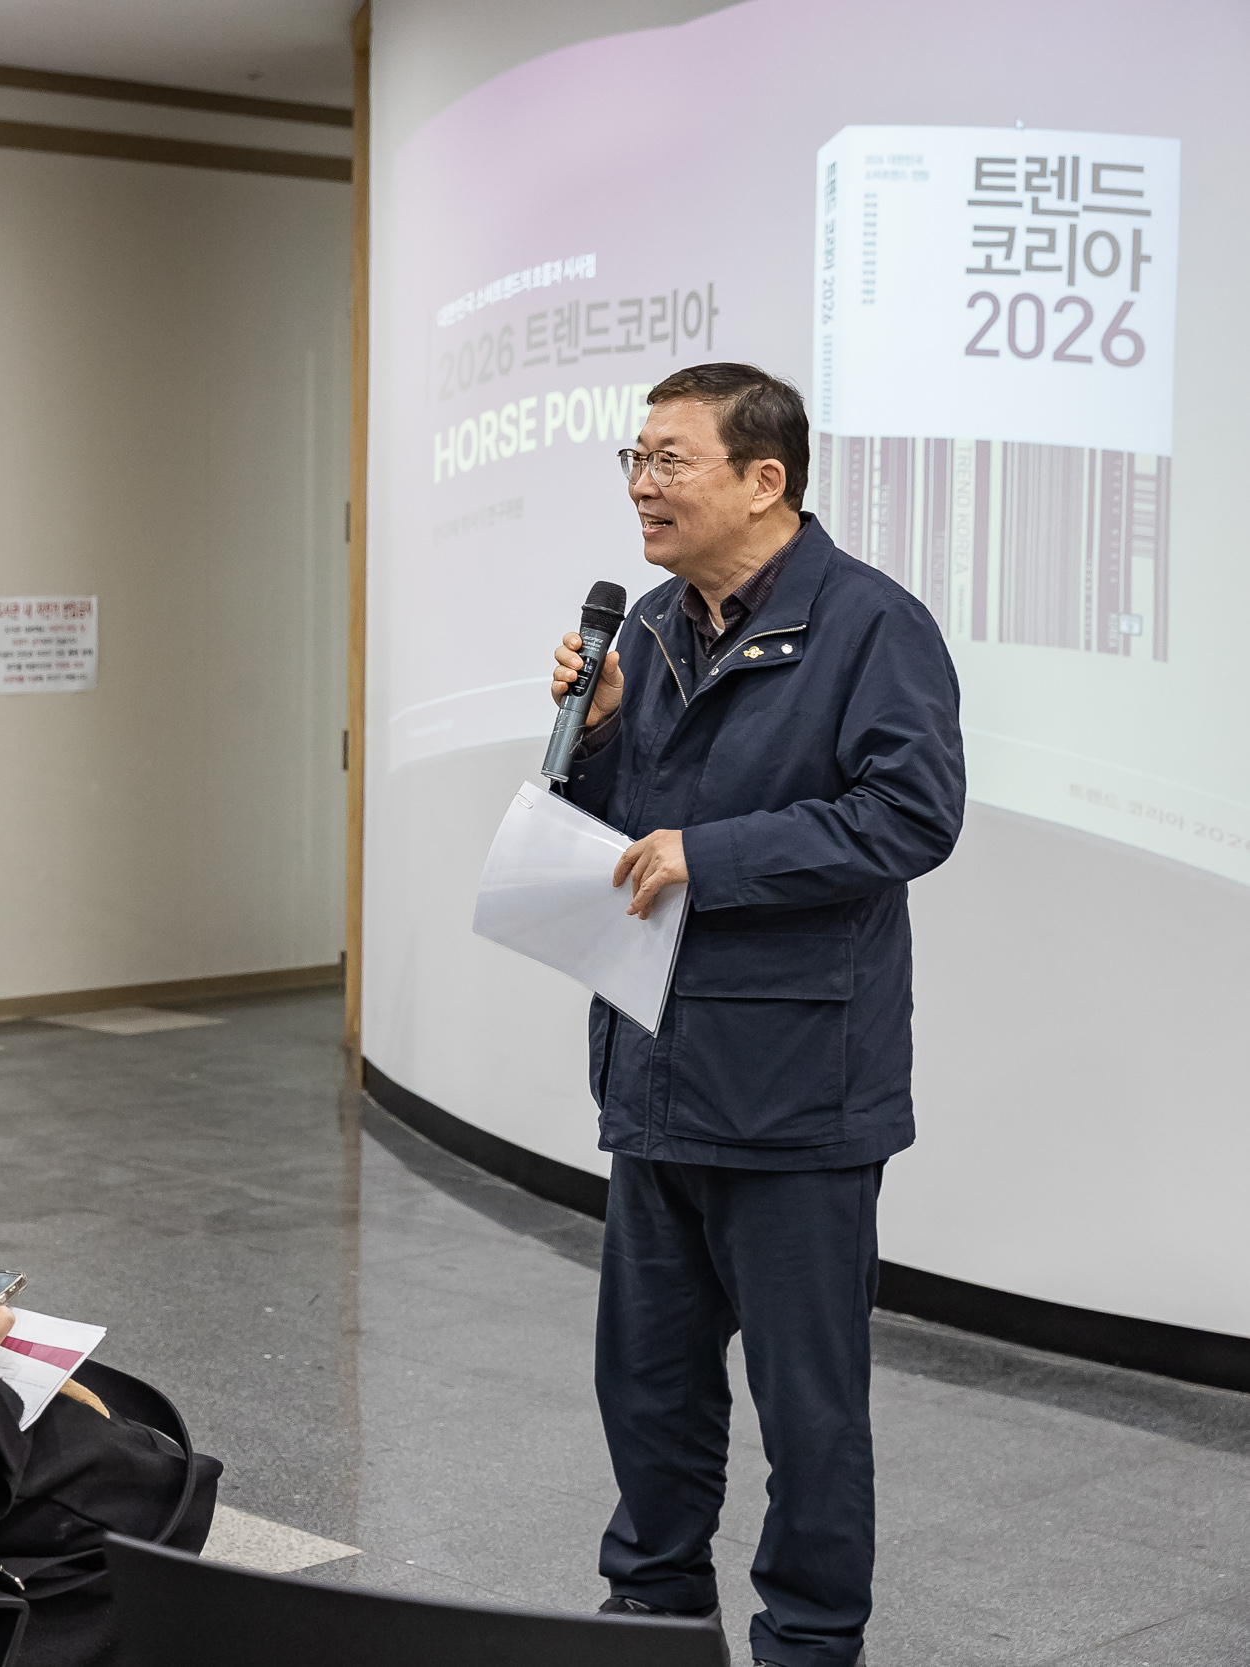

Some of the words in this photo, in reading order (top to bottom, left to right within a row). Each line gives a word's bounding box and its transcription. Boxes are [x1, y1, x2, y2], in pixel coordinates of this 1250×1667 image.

[967, 155, 1152, 217] 트렌드
[965, 223, 1152, 293] 코리아
[822, 276, 835, 325] 2026
[964, 291, 1146, 368] 2026
[437, 322, 515, 402] 2026
[522, 281, 720, 368] 트렌드코리아
[433, 395, 539, 485] HORSE
[543, 382, 656, 448] POWE
[955, 513, 970, 574] KOREA
[1125, 799, 1186, 831] 코리아
